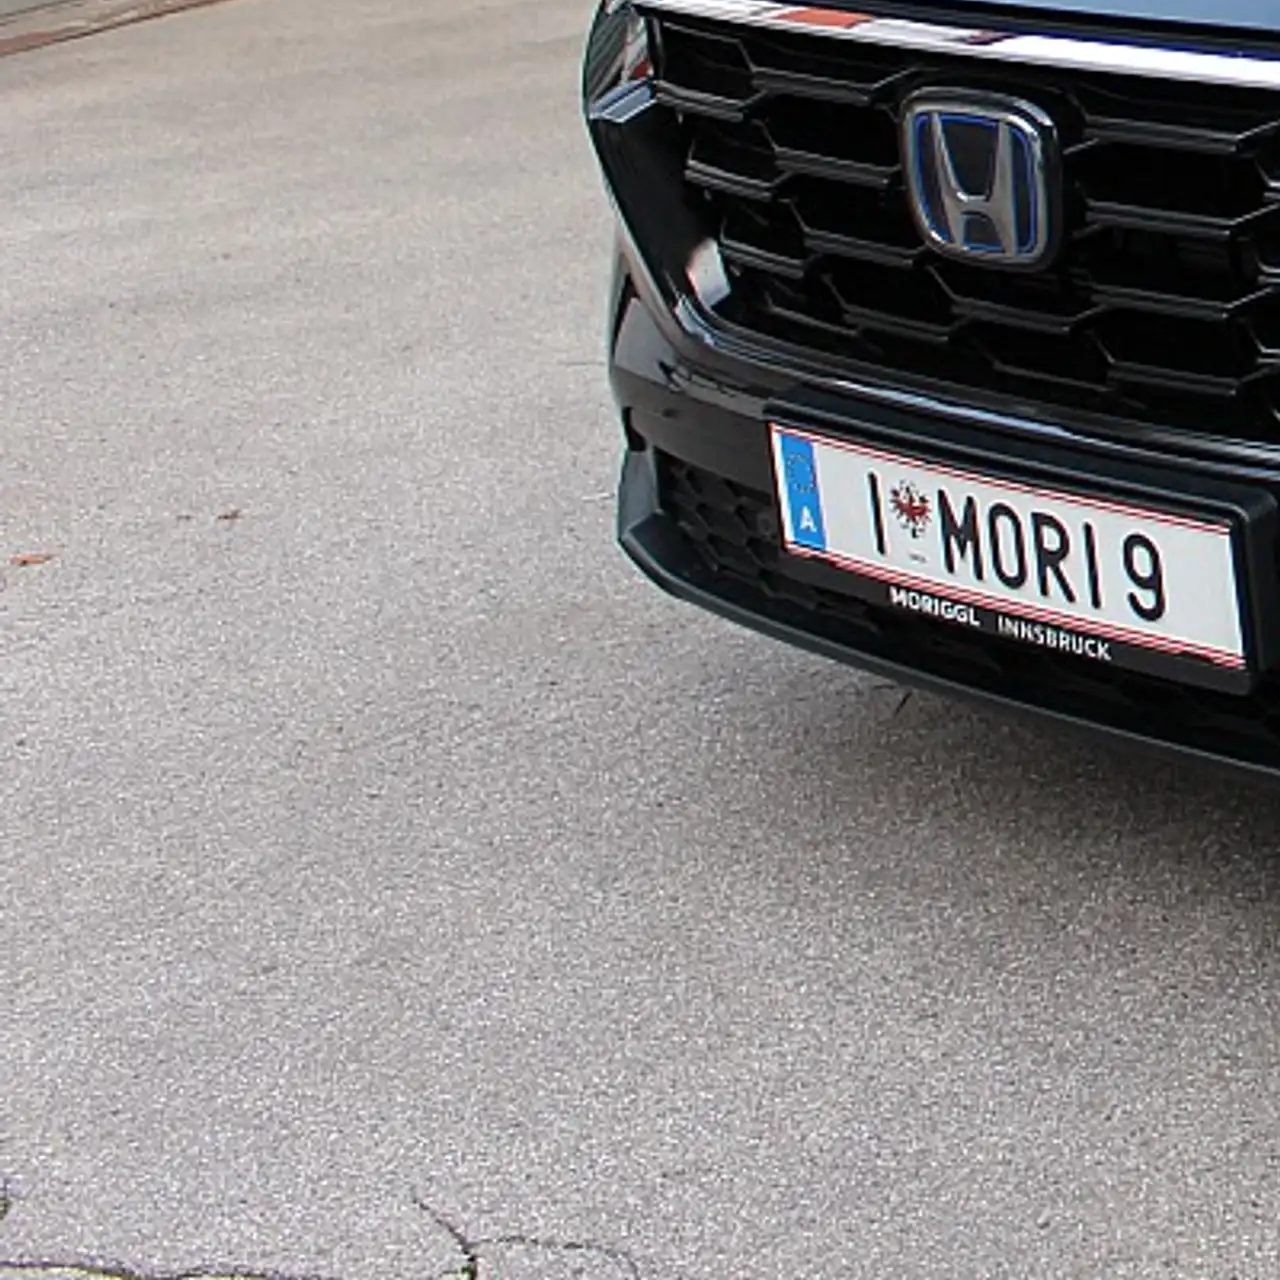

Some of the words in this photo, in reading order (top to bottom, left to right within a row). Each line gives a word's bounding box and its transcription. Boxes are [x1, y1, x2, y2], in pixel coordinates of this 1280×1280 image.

[799, 505, 817, 533] A
[1122, 533, 1166, 622] 9
[889, 586, 981, 628] MORIGGL
[998, 614, 1113, 662] INNSBRUCK
